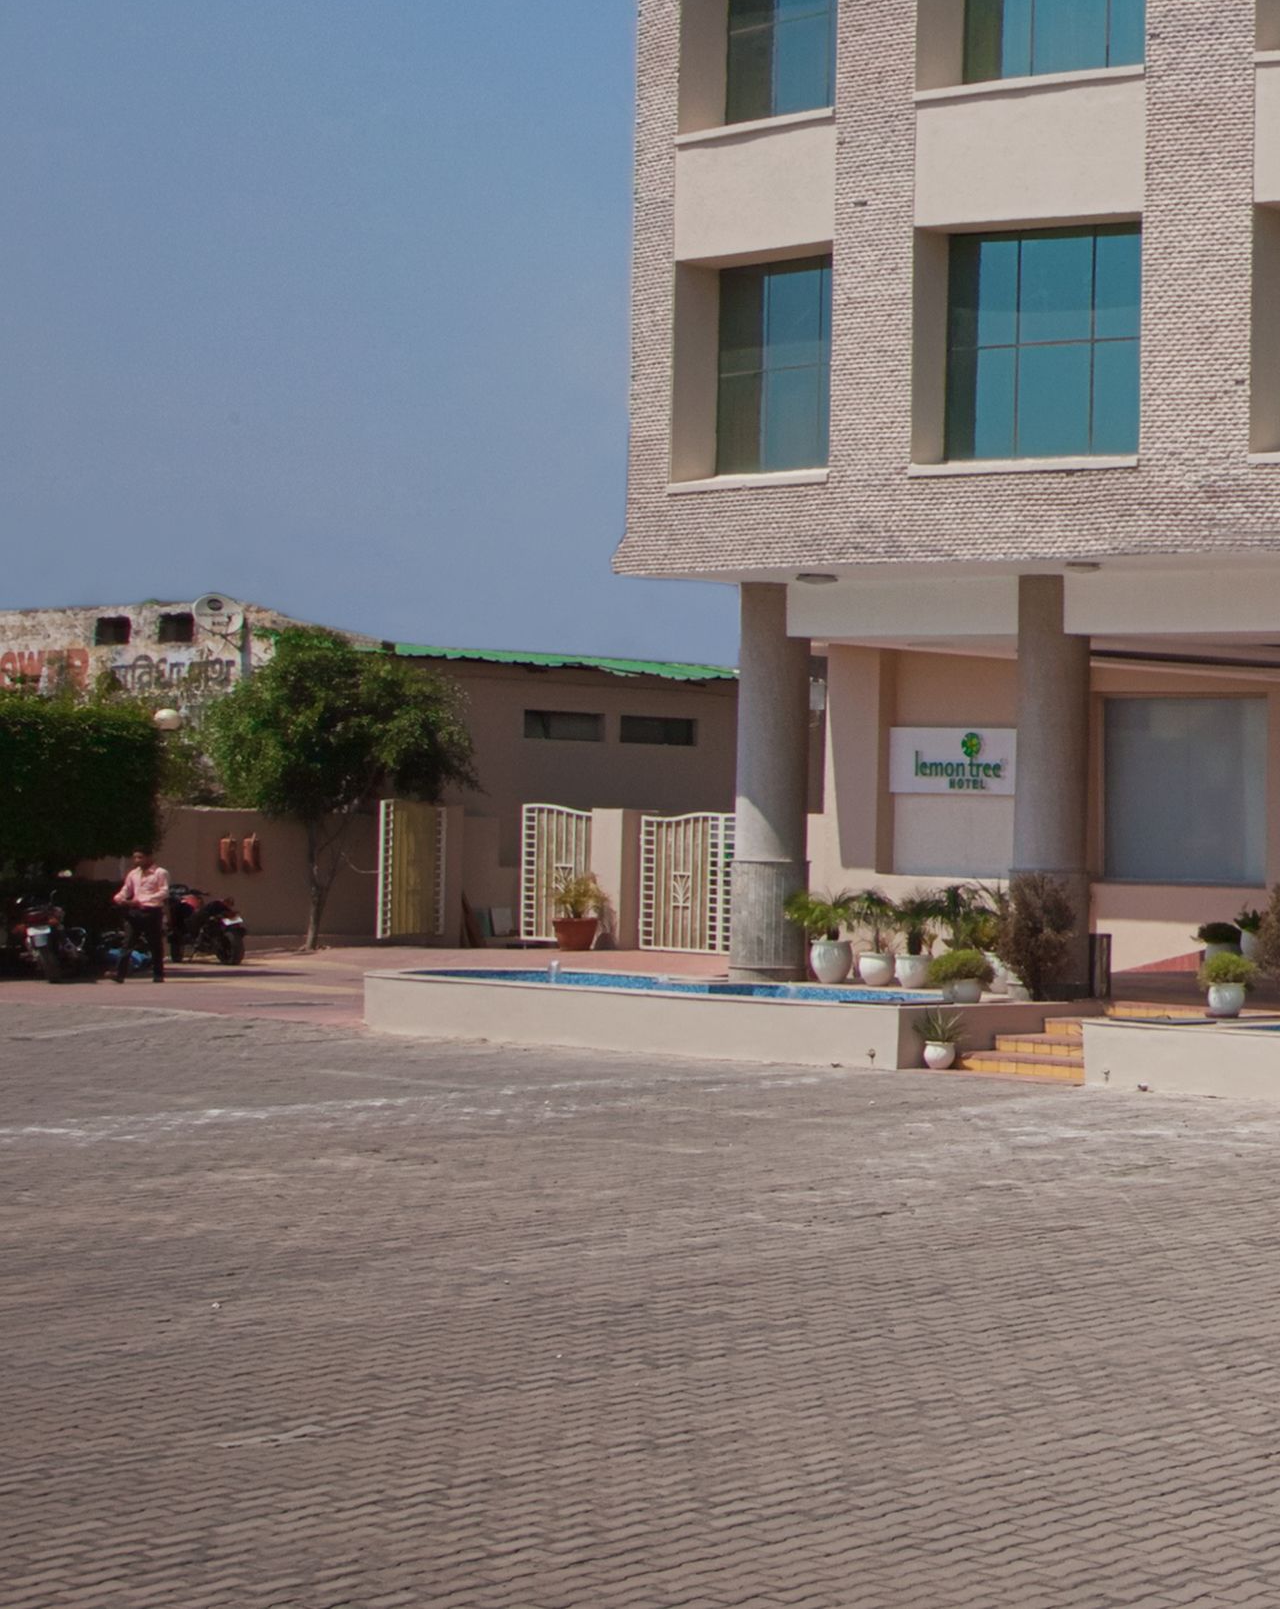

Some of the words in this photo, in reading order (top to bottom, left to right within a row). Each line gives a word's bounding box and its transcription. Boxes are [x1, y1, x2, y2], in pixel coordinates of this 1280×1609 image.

[915, 750, 965, 778] lemon
[969, 757, 1002, 778] tree
[949, 778, 986, 790] HOTEL
